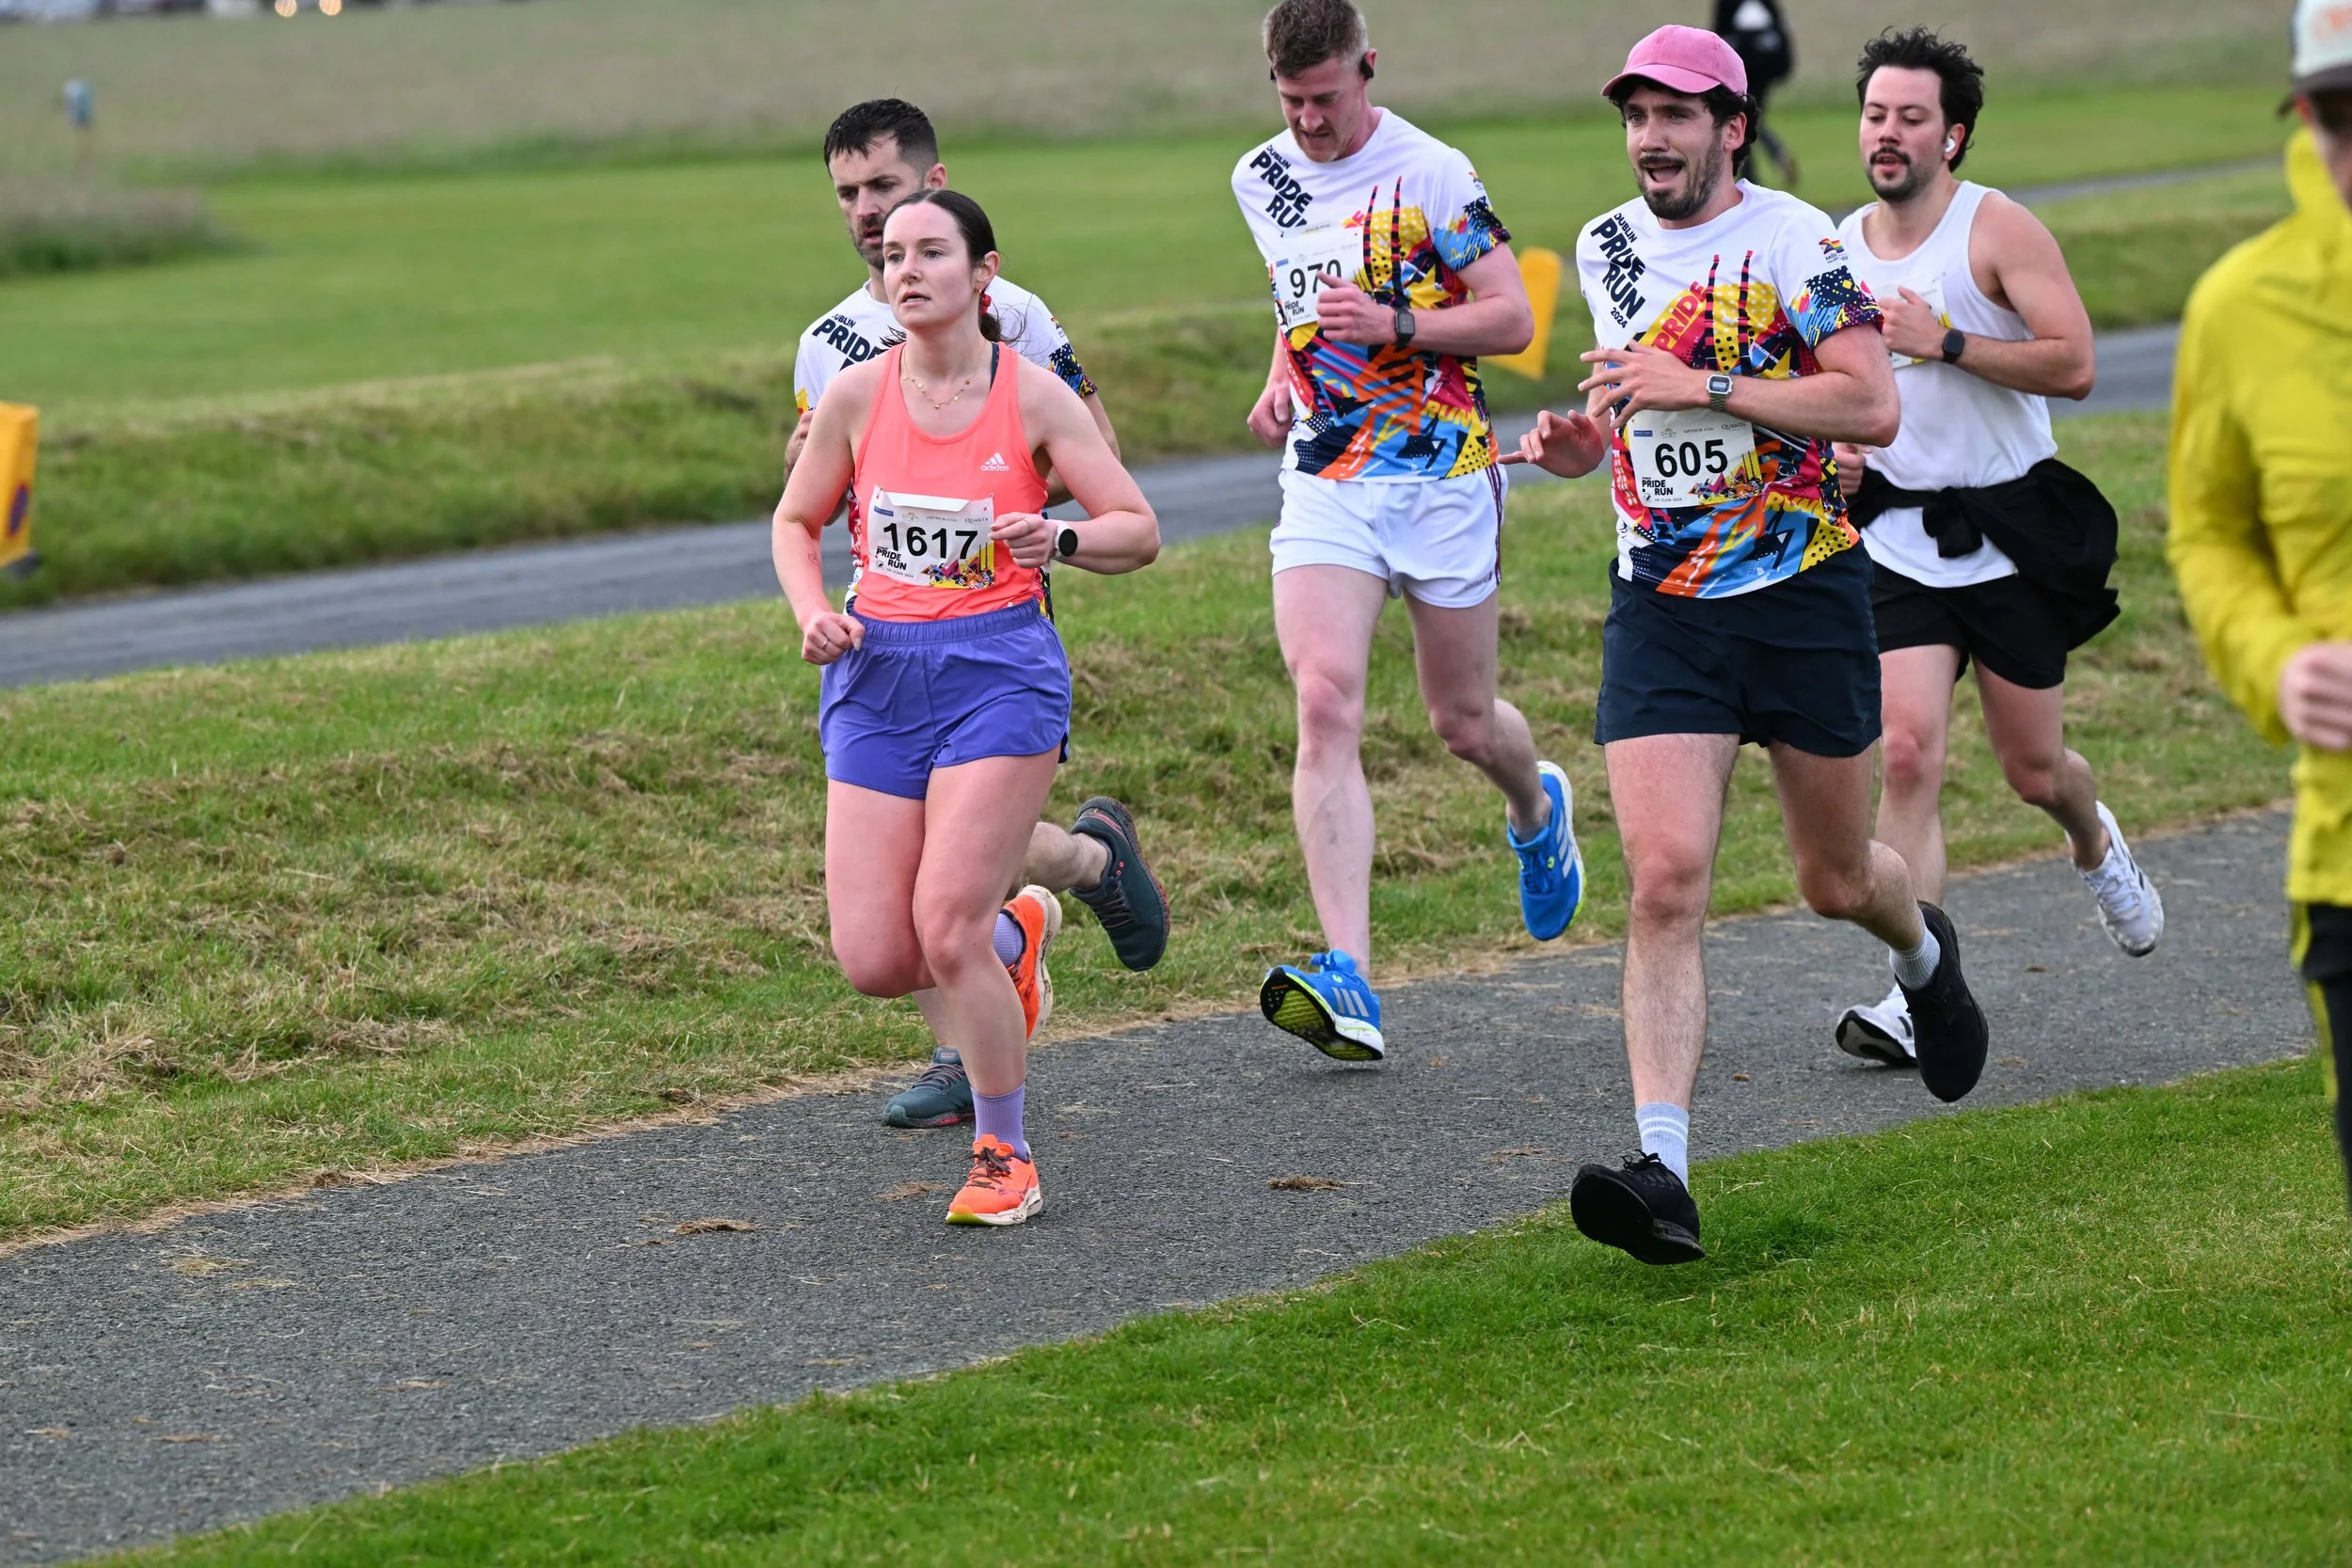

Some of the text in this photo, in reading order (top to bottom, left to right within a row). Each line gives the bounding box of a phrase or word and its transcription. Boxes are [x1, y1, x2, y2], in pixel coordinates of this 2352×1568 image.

[1266, 144, 1292, 170] DUBLIN
[1249, 150, 1313, 214] PRIDE
[1265, 194, 1308, 228] RU
[1613, 213, 1637, 243] DUBLIN
[1601, 262, 1646, 320] RUN
[832, 313, 856, 328] UBLIN
[1610, 307, 1629, 328] 2024
[1420, 400, 1471, 428] RUN
[1721, 422, 1746, 431] QUANTA
[980, 464, 1009, 472] adidas
[1655, 439, 1728, 478] 605
[1642, 480, 1666, 488] PRIDE
[1655, 487, 1674, 496] RUN
[883, 522, 978, 560] 1617
[876, 547, 902, 562] PRIDE
[887, 559, 907, 570] RUN
